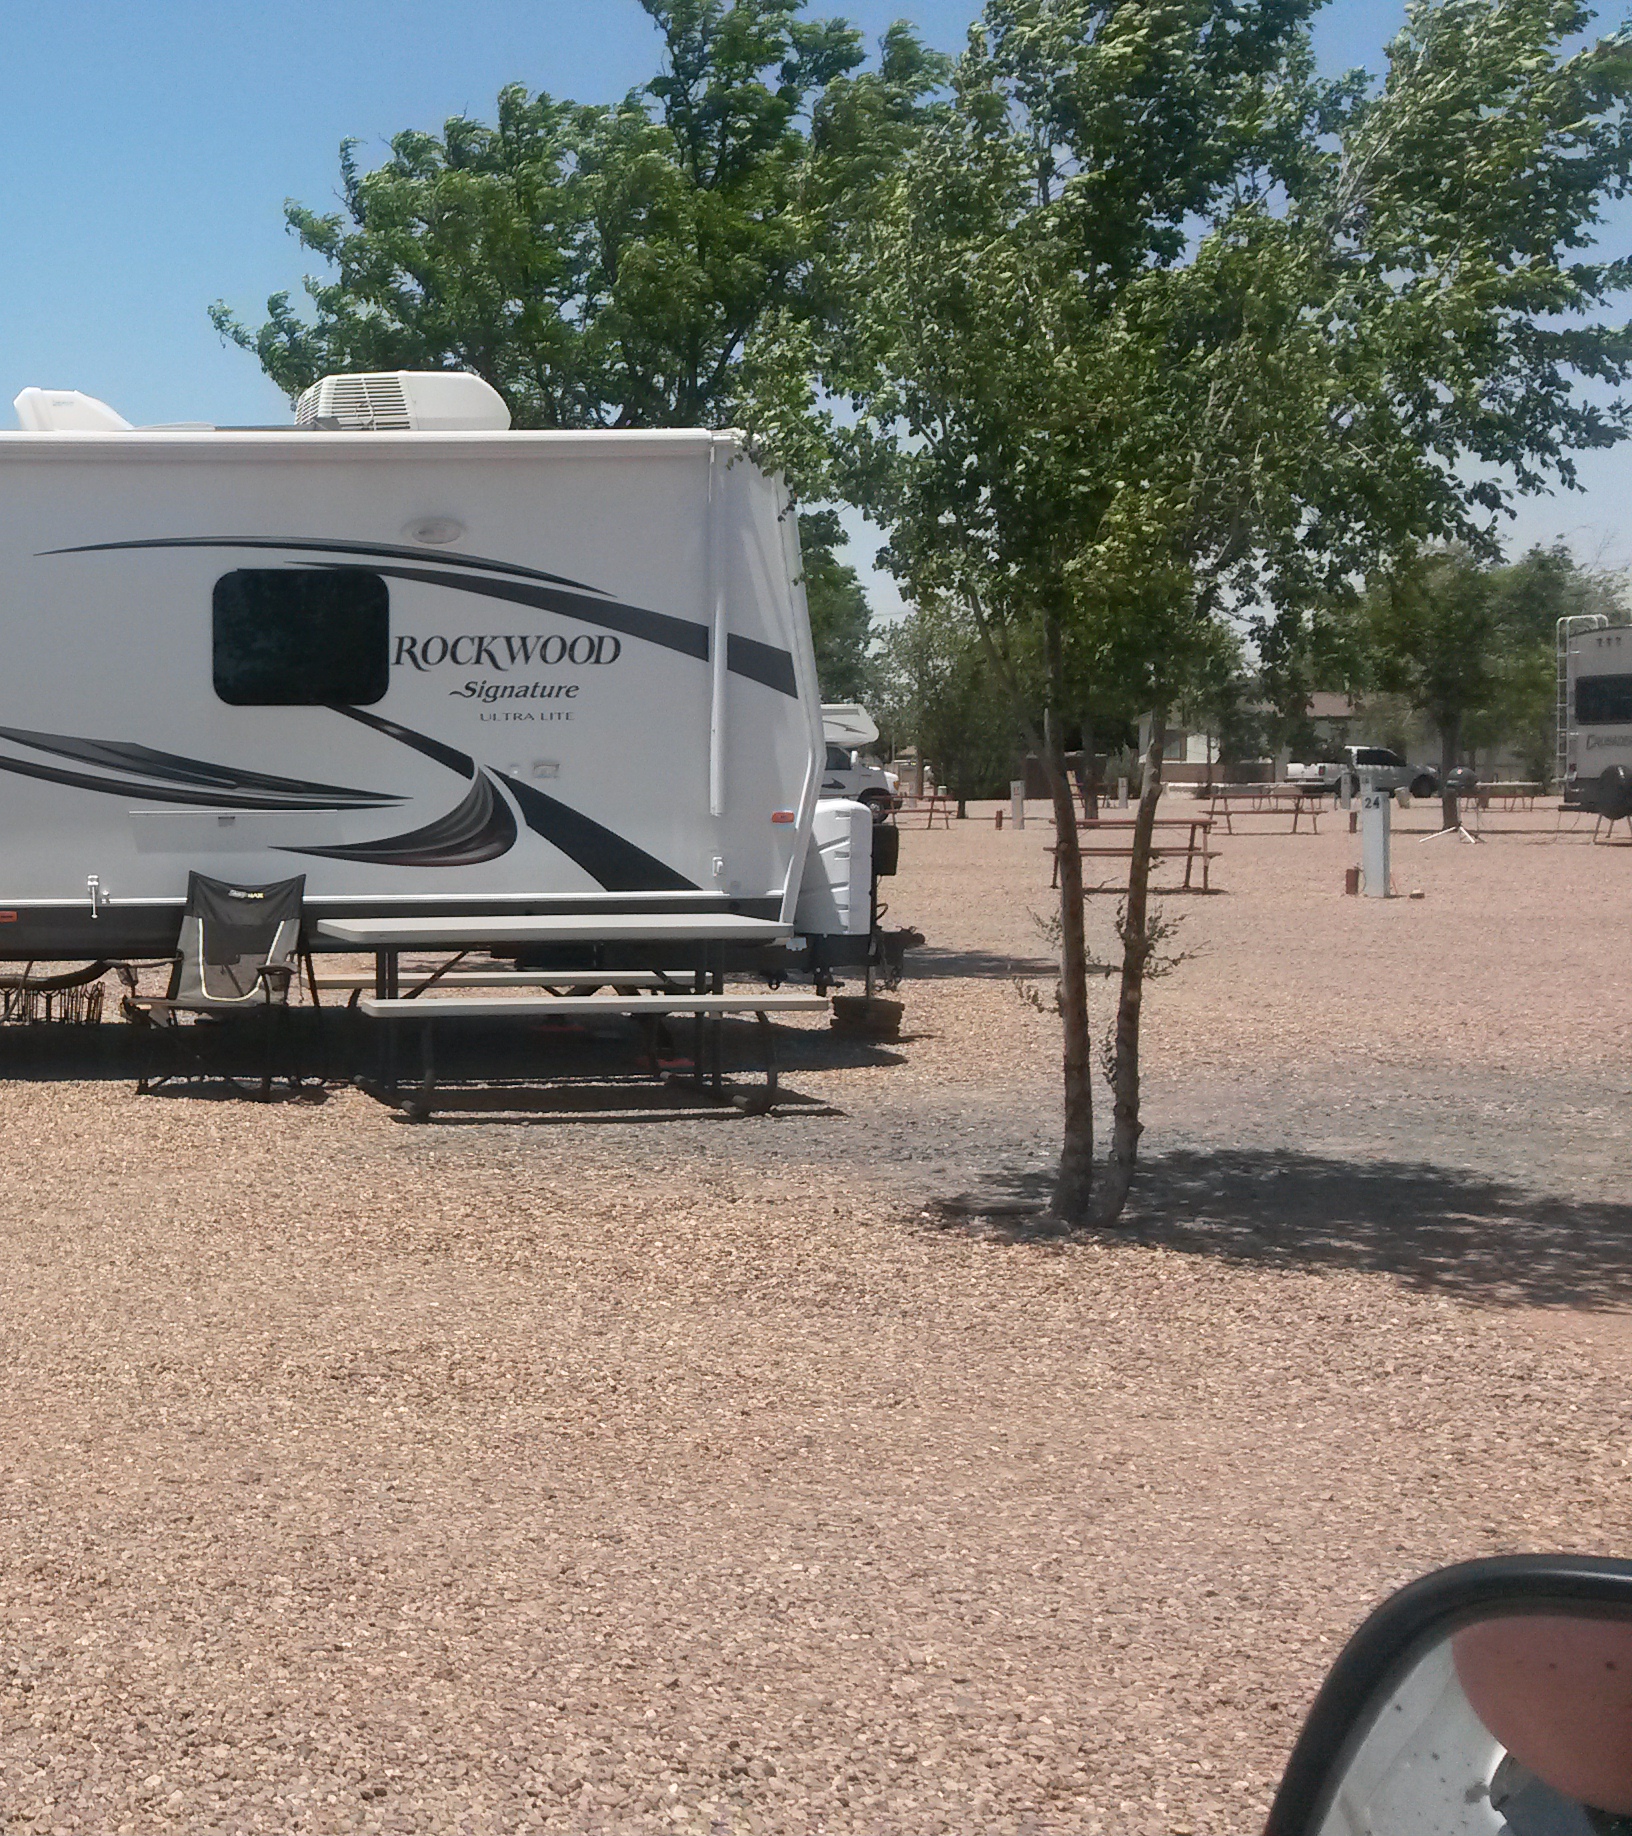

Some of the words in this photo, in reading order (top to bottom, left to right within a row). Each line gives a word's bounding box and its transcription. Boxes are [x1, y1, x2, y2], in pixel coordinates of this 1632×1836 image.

[391, 634, 622, 672] ROCKWOOD
[449, 680, 580, 703] Signature
[480, 712, 535, 721] ULTRA
[540, 711, 575, 721] LITE
[1364, 796, 1380, 809] 24
